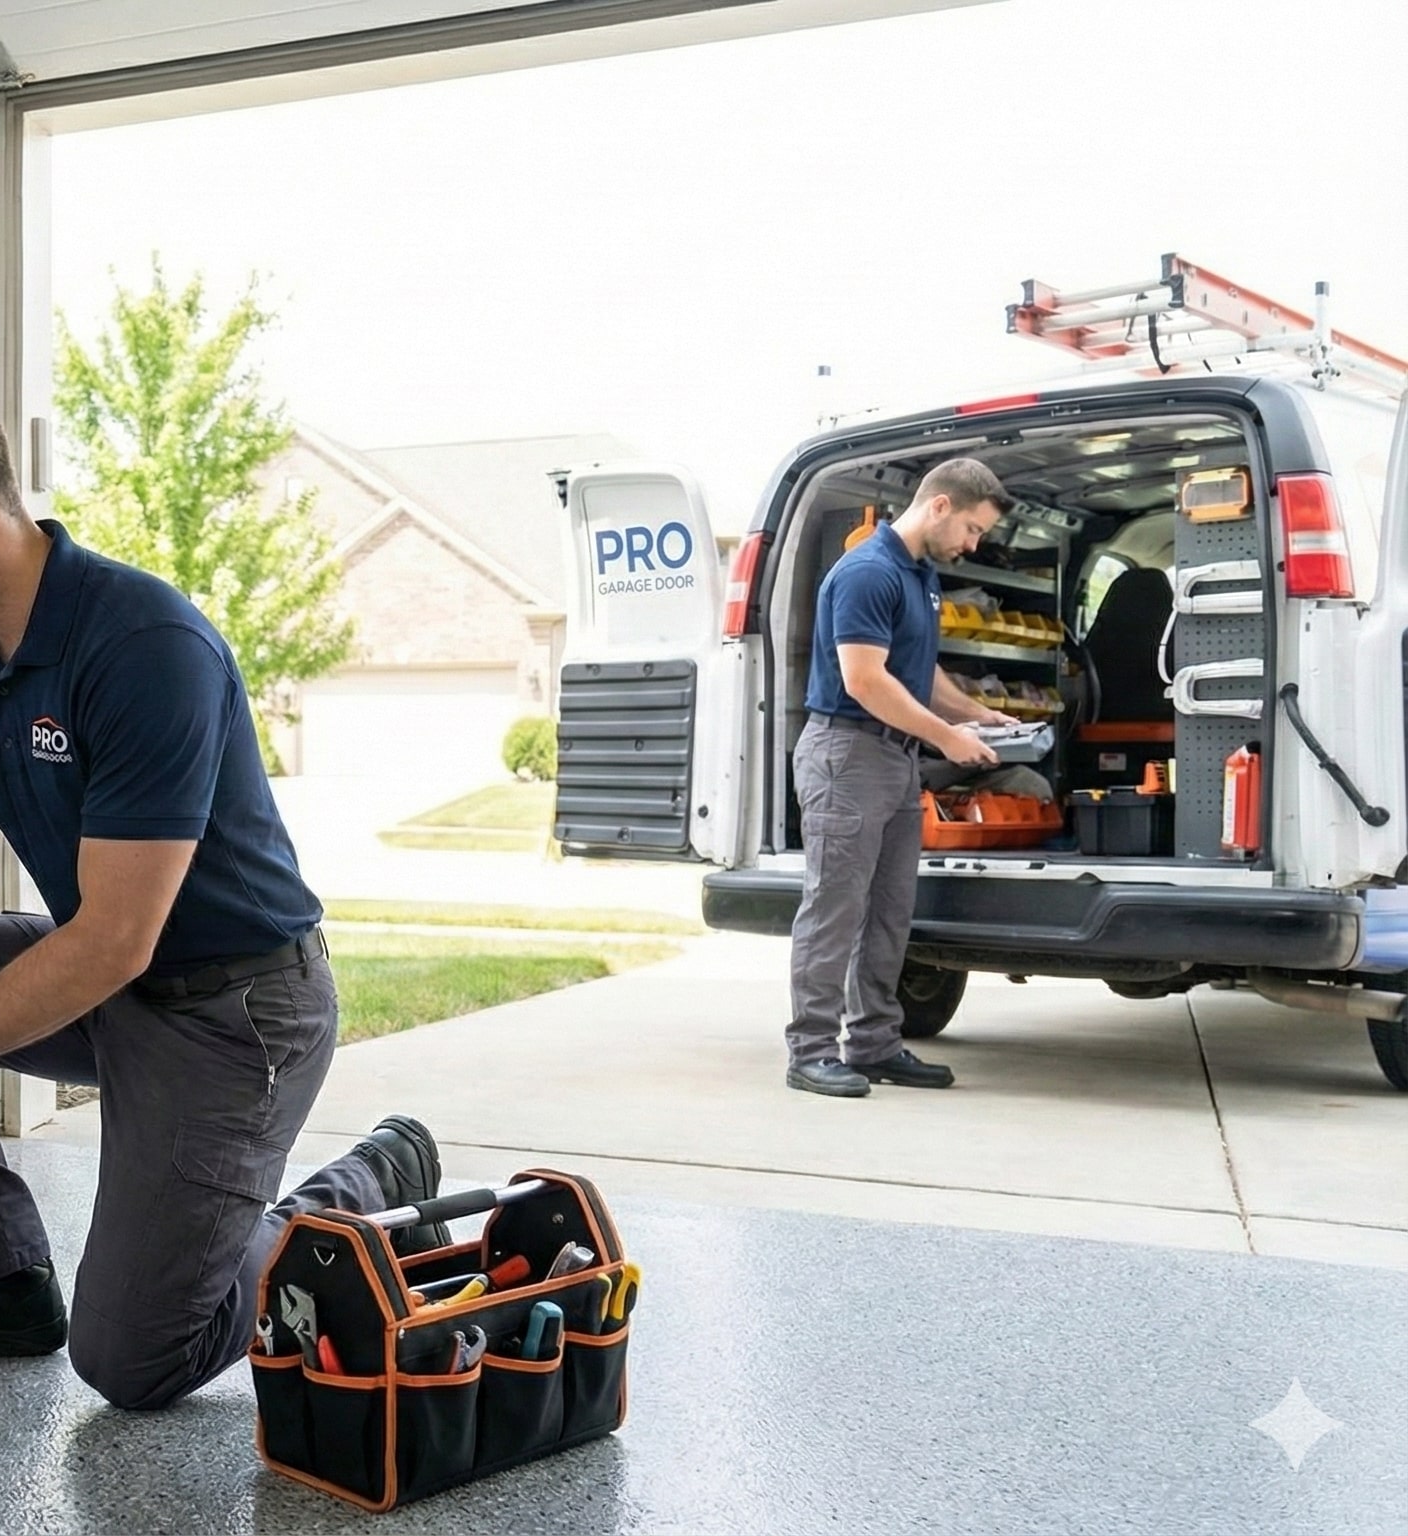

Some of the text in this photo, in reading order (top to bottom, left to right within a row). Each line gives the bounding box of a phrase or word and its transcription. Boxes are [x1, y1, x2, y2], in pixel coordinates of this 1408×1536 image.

[595, 522, 693, 575] PRO
[598, 575, 694, 595] GARAGE DOOR
[32, 725, 68, 753] PRO
